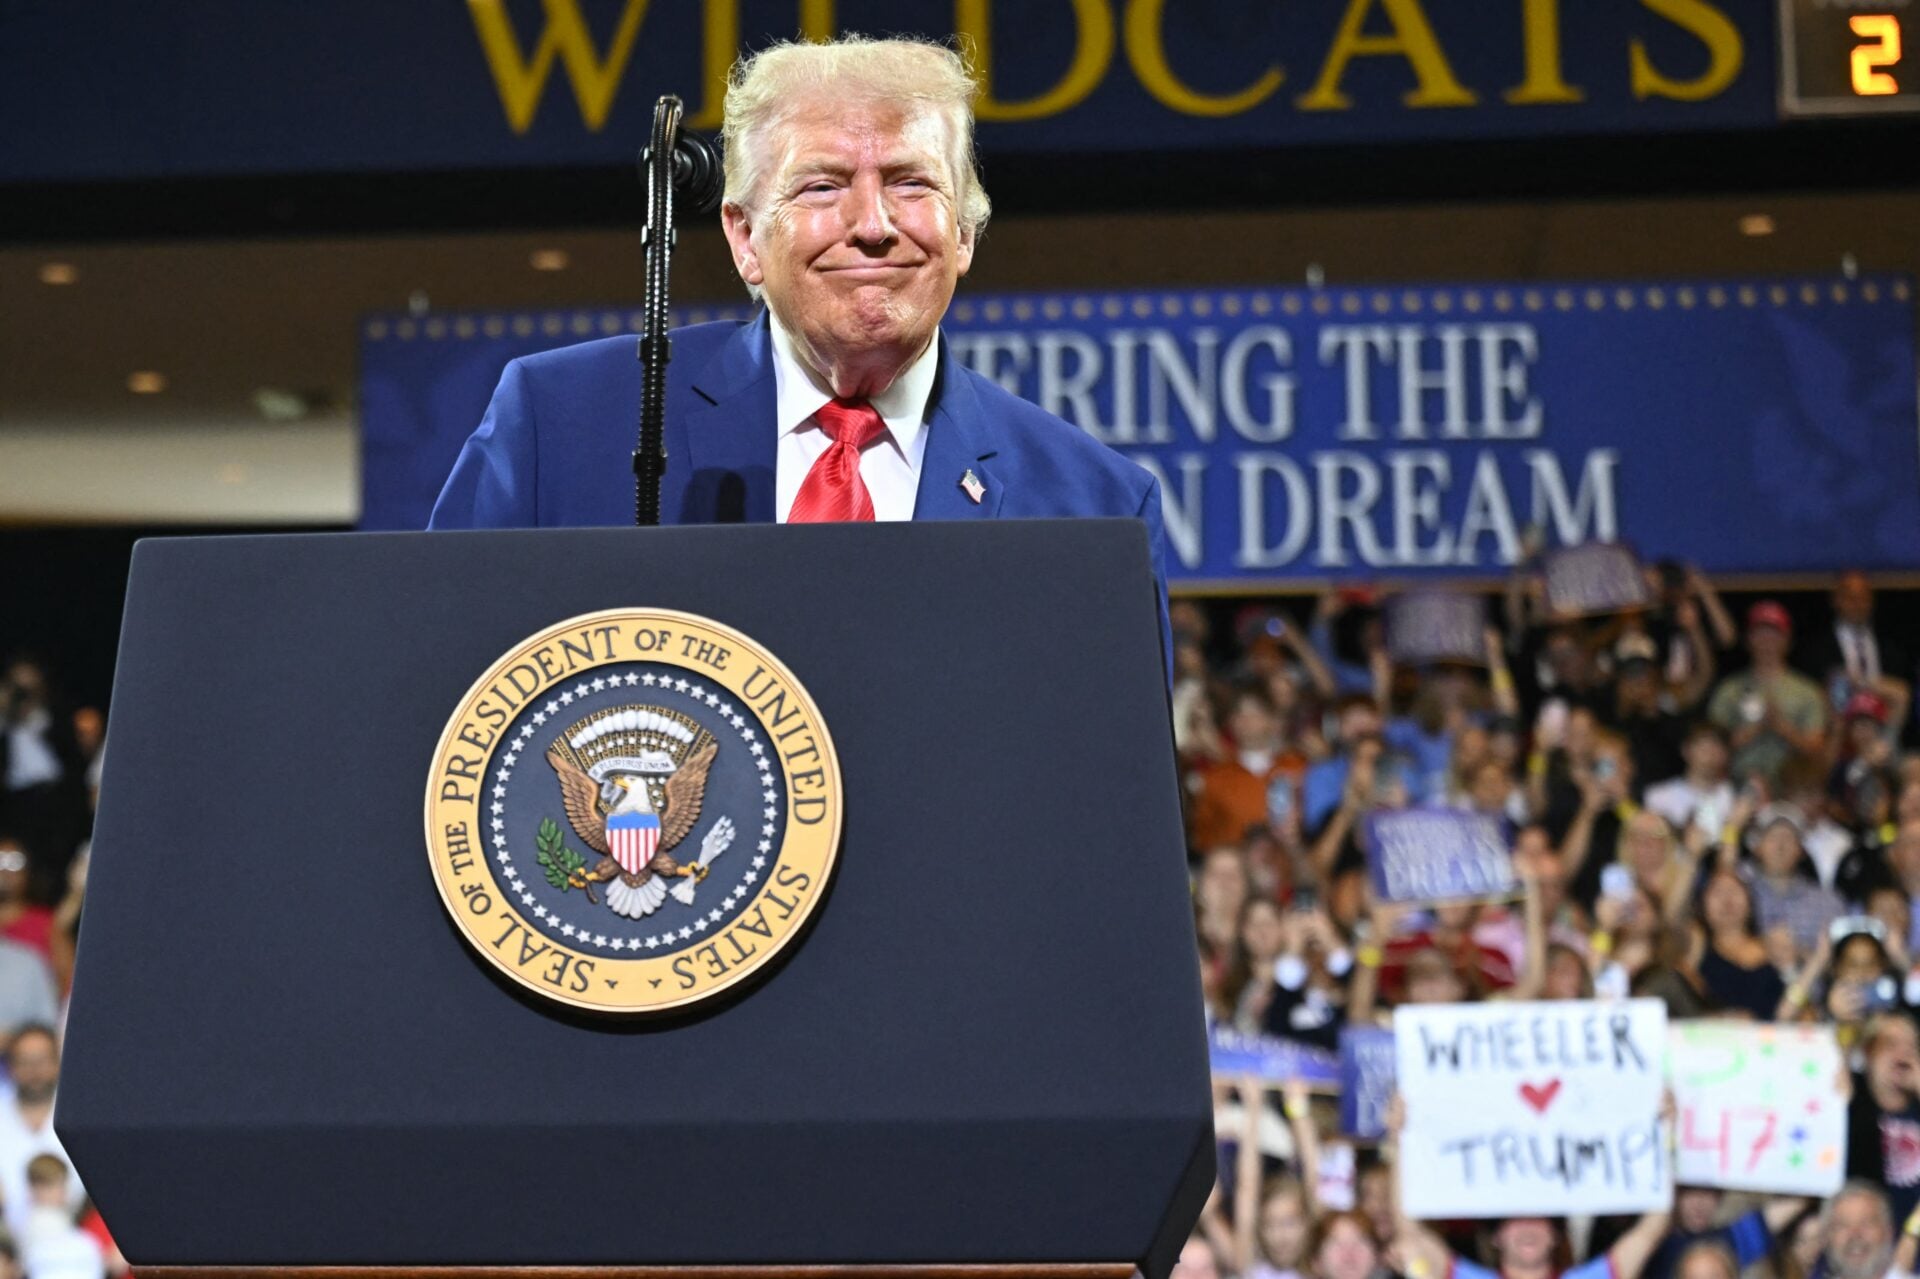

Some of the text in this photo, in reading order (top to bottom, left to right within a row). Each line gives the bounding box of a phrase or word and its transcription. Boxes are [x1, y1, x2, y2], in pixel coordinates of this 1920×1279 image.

[1849, 14, 1901, 95] 2
[1318, 322, 1544, 441] THE
[1232, 448, 1620, 568] DREAM
[440, 625, 828, 994] SEAL OF THE PRESIDENT OF THE UNITED STATES
[1417, 1012, 1648, 1072] WHEELER
[1440, 1116, 1665, 1194] TRUMP!
[1682, 1105, 1778, 1180] 47
